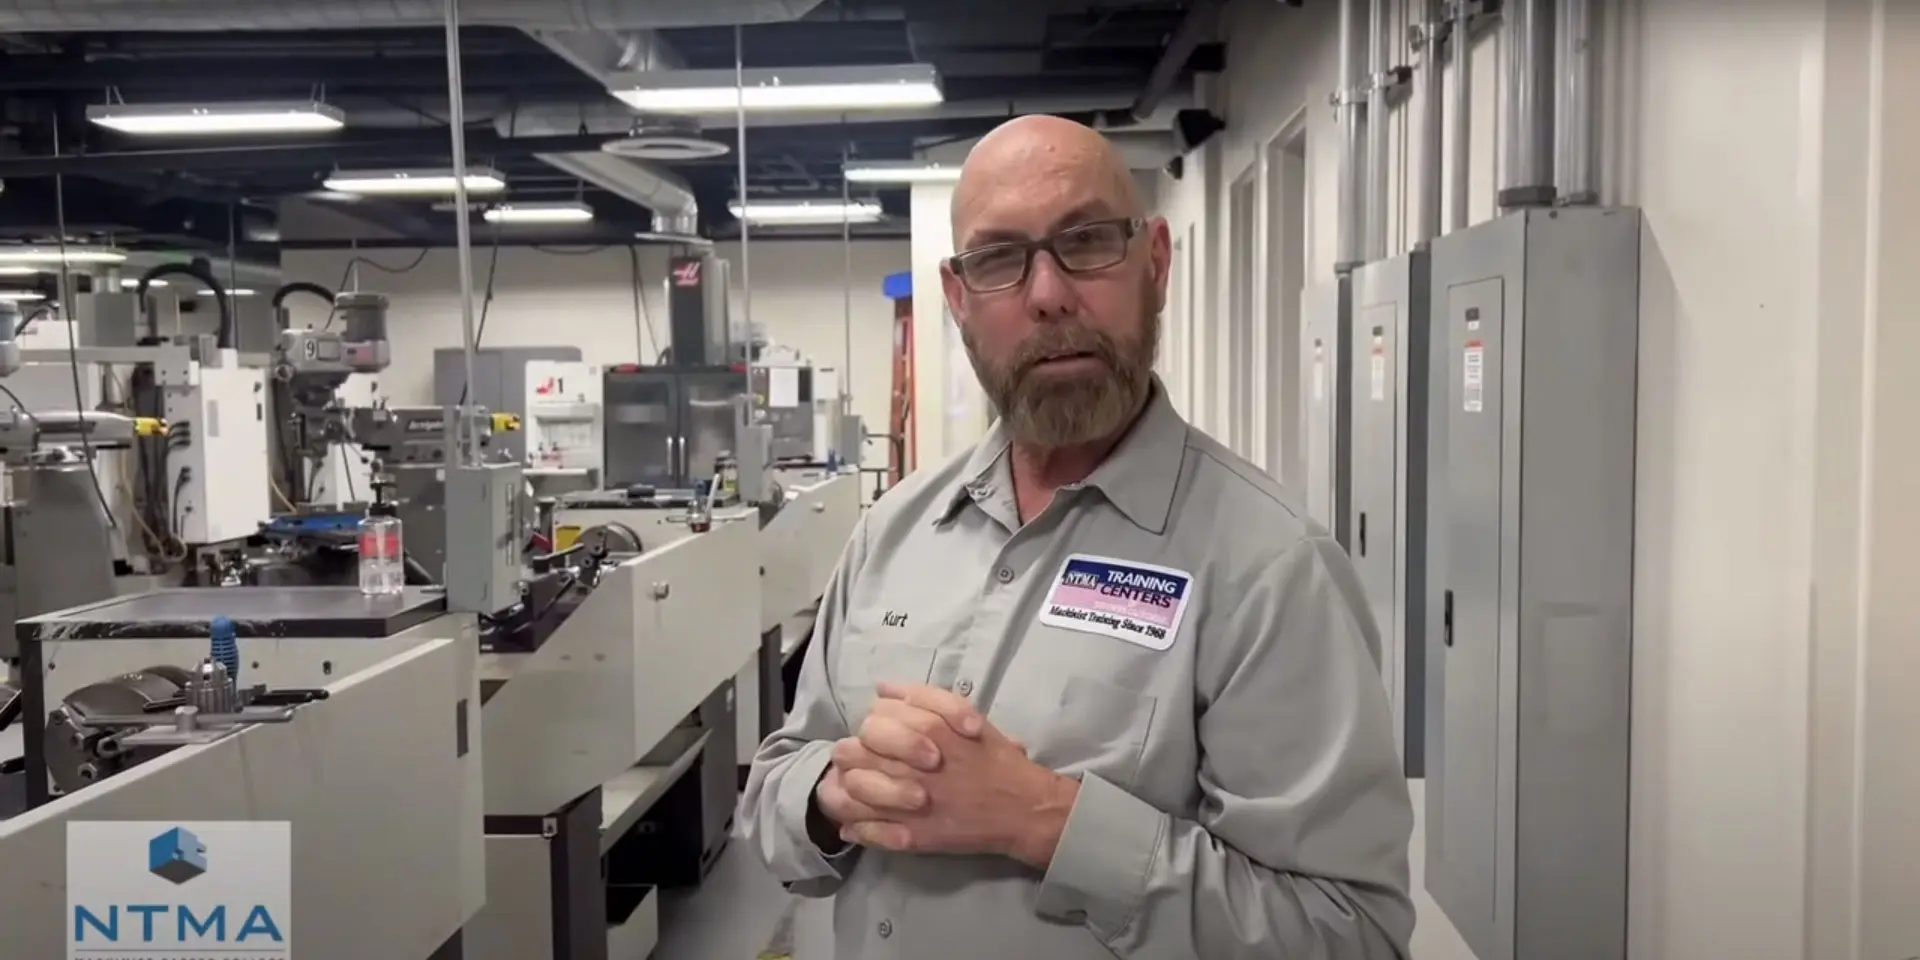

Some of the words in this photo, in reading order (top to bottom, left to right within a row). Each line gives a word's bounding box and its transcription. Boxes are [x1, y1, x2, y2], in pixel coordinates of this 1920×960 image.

[306, 340, 316, 358] 9
[1064, 571, 1099, 589] NTMA
[1107, 570, 1177, 594] TRAINING
[1100, 583, 1173, 608] CENTERS
[881, 610, 908, 628] Kurt
[1050, 605, 1088, 621] Machinist
[1088, 612, 1121, 630] Training
[1121, 618, 1145, 633] Since
[1145, 626, 1167, 640] 1968
